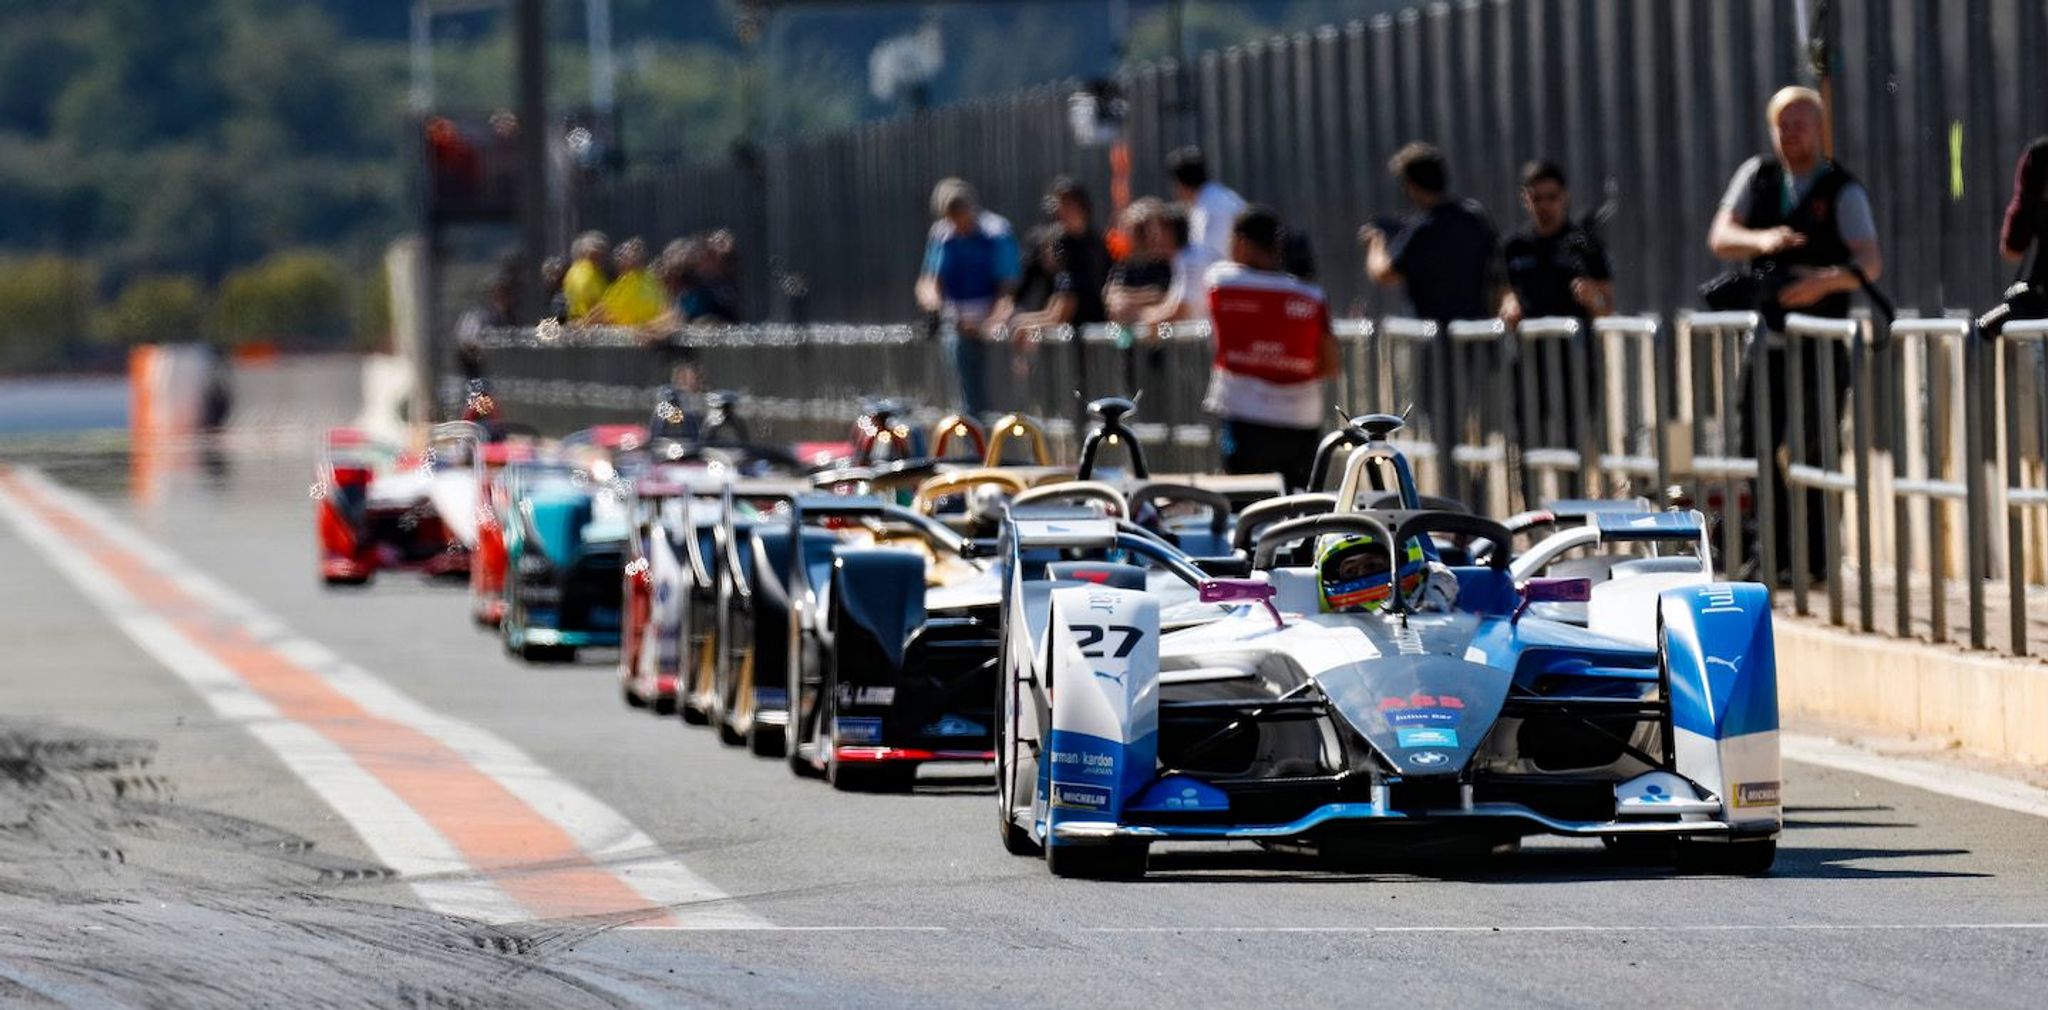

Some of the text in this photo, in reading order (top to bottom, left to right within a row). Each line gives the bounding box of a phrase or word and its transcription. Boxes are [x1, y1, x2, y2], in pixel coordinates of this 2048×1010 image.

[1068, 624, 1145, 659] 27
[1082, 751, 1114, 767] kardon
[1062, 791, 1107, 805] MICHELIN
